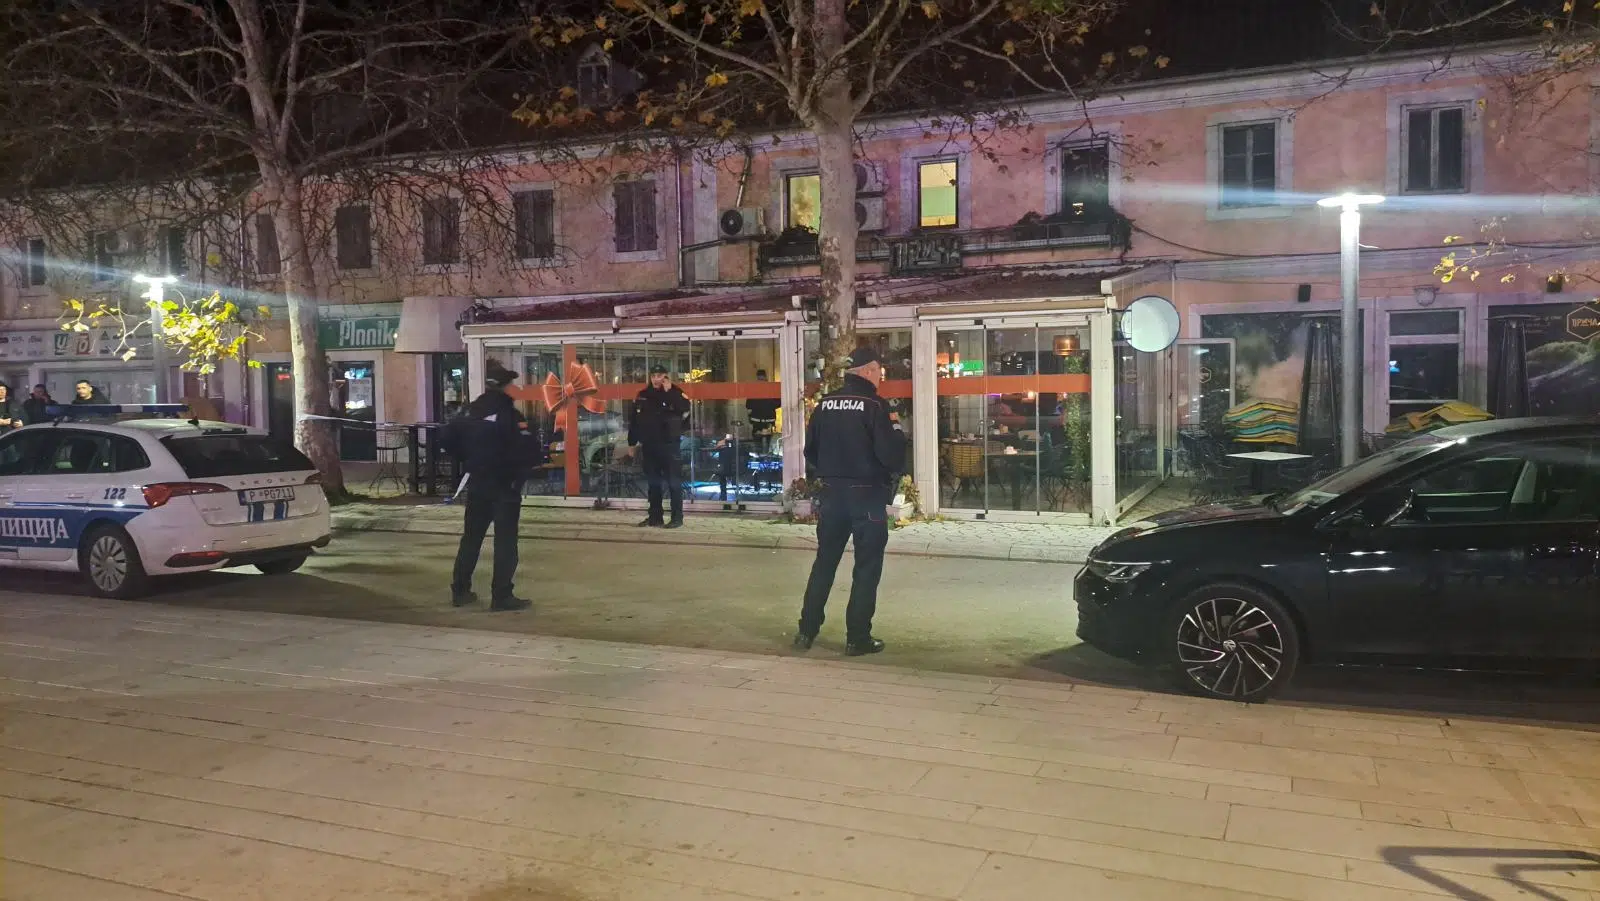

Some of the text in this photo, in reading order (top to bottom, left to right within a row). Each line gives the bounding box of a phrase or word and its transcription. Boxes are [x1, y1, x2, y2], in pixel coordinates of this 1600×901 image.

[821, 399, 864, 411] POLICIJA
[103, 487, 126, 500] 122
[263, 488, 293, 500] PG711
